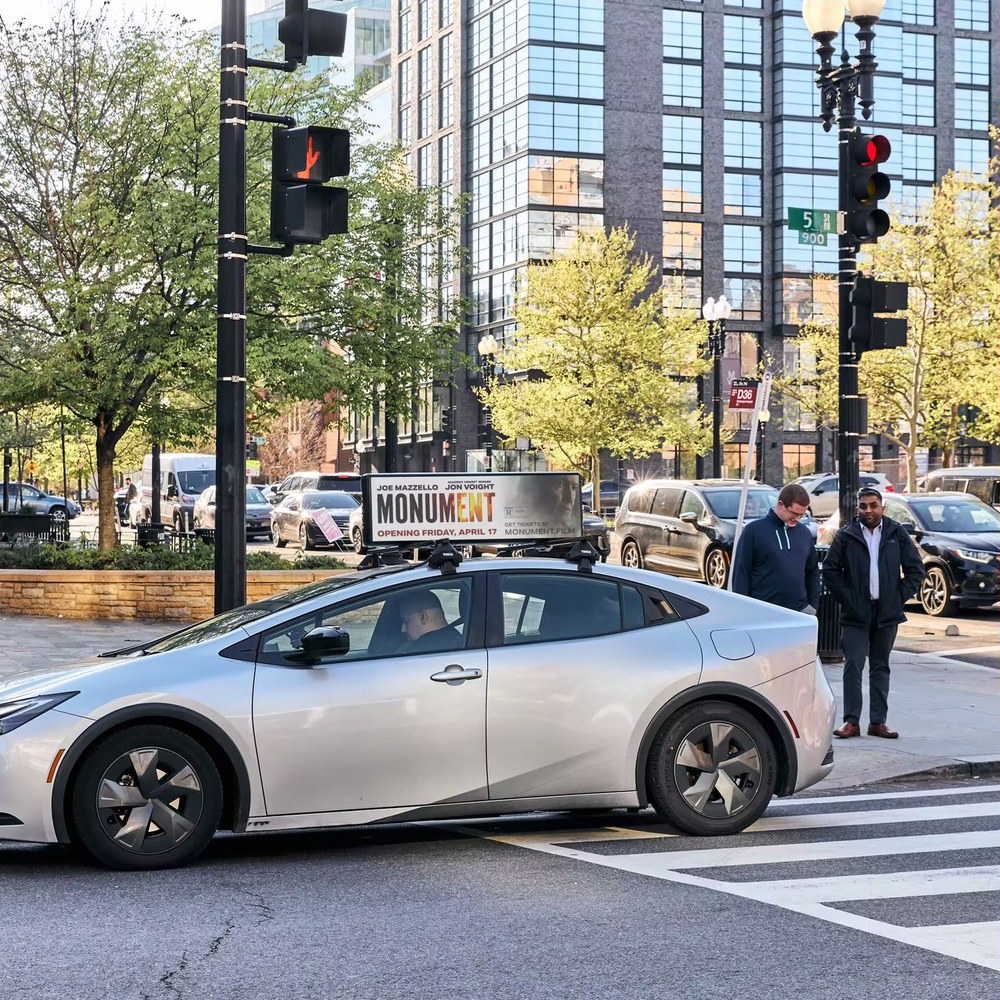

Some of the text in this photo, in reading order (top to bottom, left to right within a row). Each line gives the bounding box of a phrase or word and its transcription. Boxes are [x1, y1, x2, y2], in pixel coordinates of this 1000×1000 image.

[803, 211, 812, 228] 5
[802, 233, 825, 245] 900
[737, 389, 753, 400] D36
[377, 493, 496, 524] MONUMENT
[377, 529, 420, 537] OPENING
[422, 529, 457, 537] FRIDAY,
